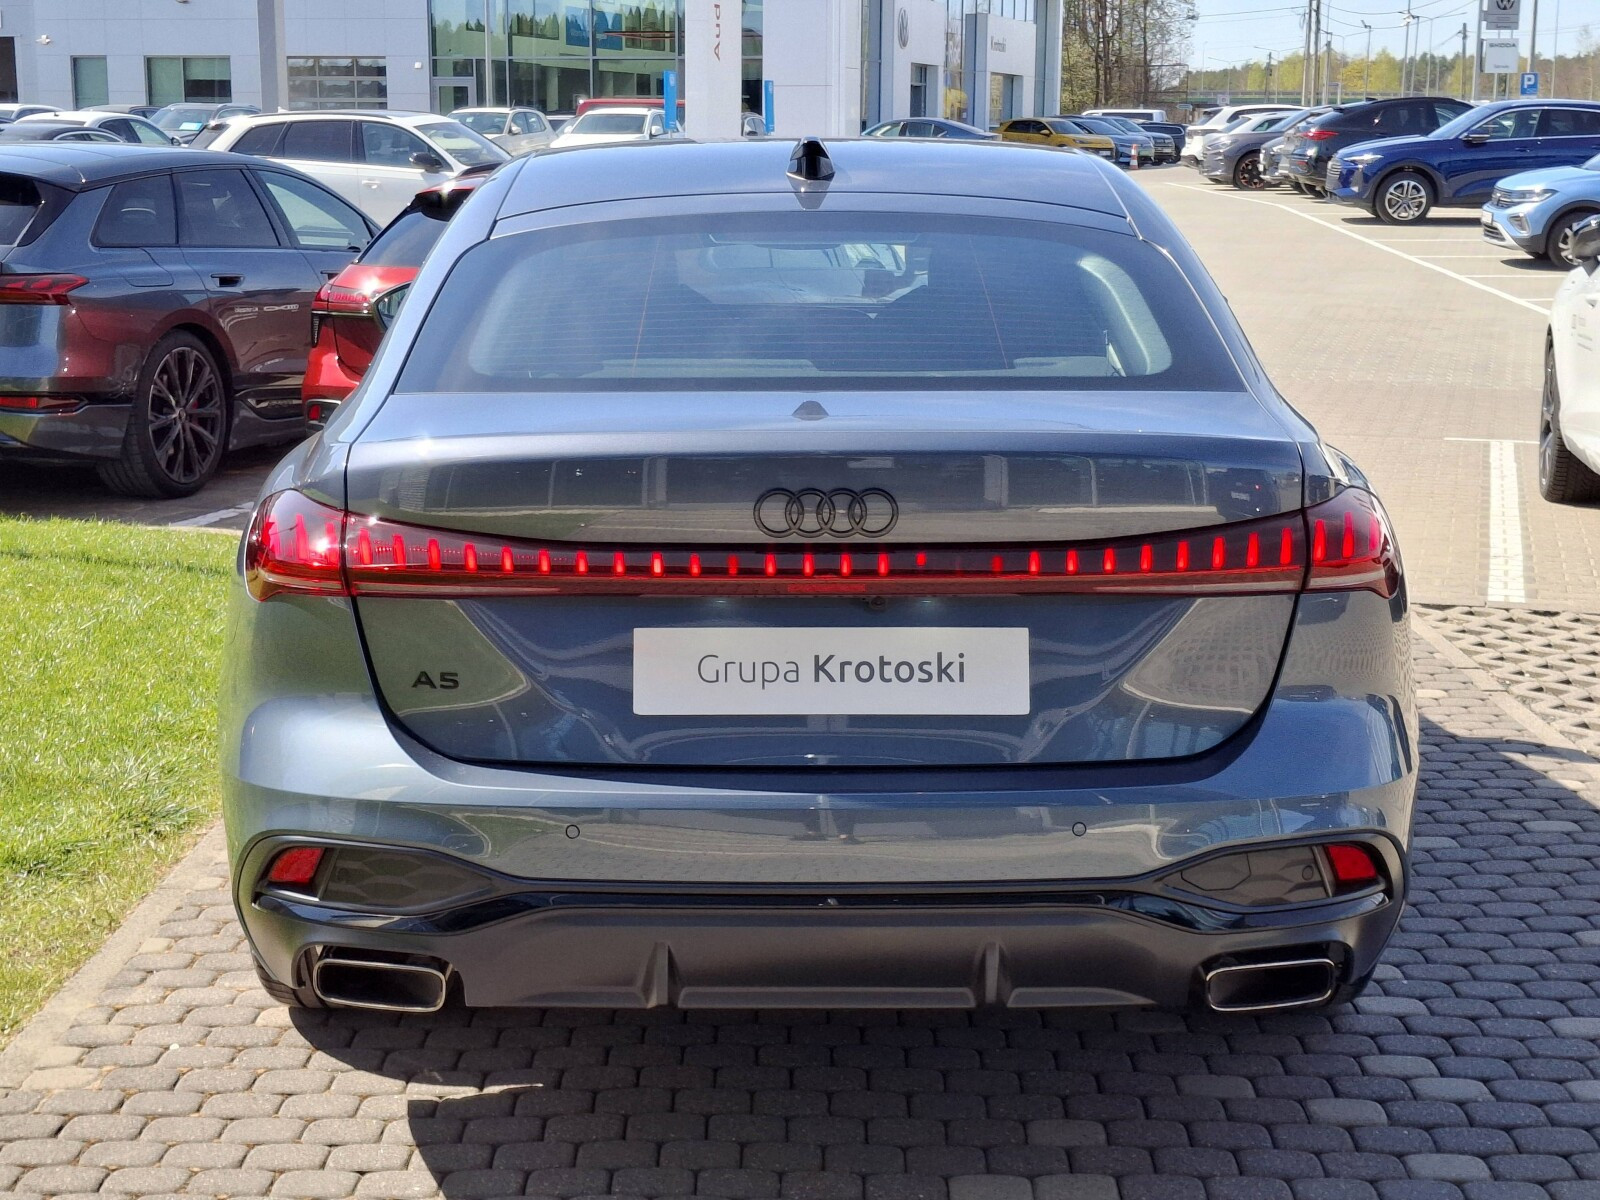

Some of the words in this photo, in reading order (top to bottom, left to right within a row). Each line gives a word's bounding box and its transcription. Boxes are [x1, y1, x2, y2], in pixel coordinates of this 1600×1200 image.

[1524, 75, 1535, 88] P
[411, 671, 459, 689] A5
[698, 655, 799, 690] Grupa
[814, 652, 965, 683] Krotoski
